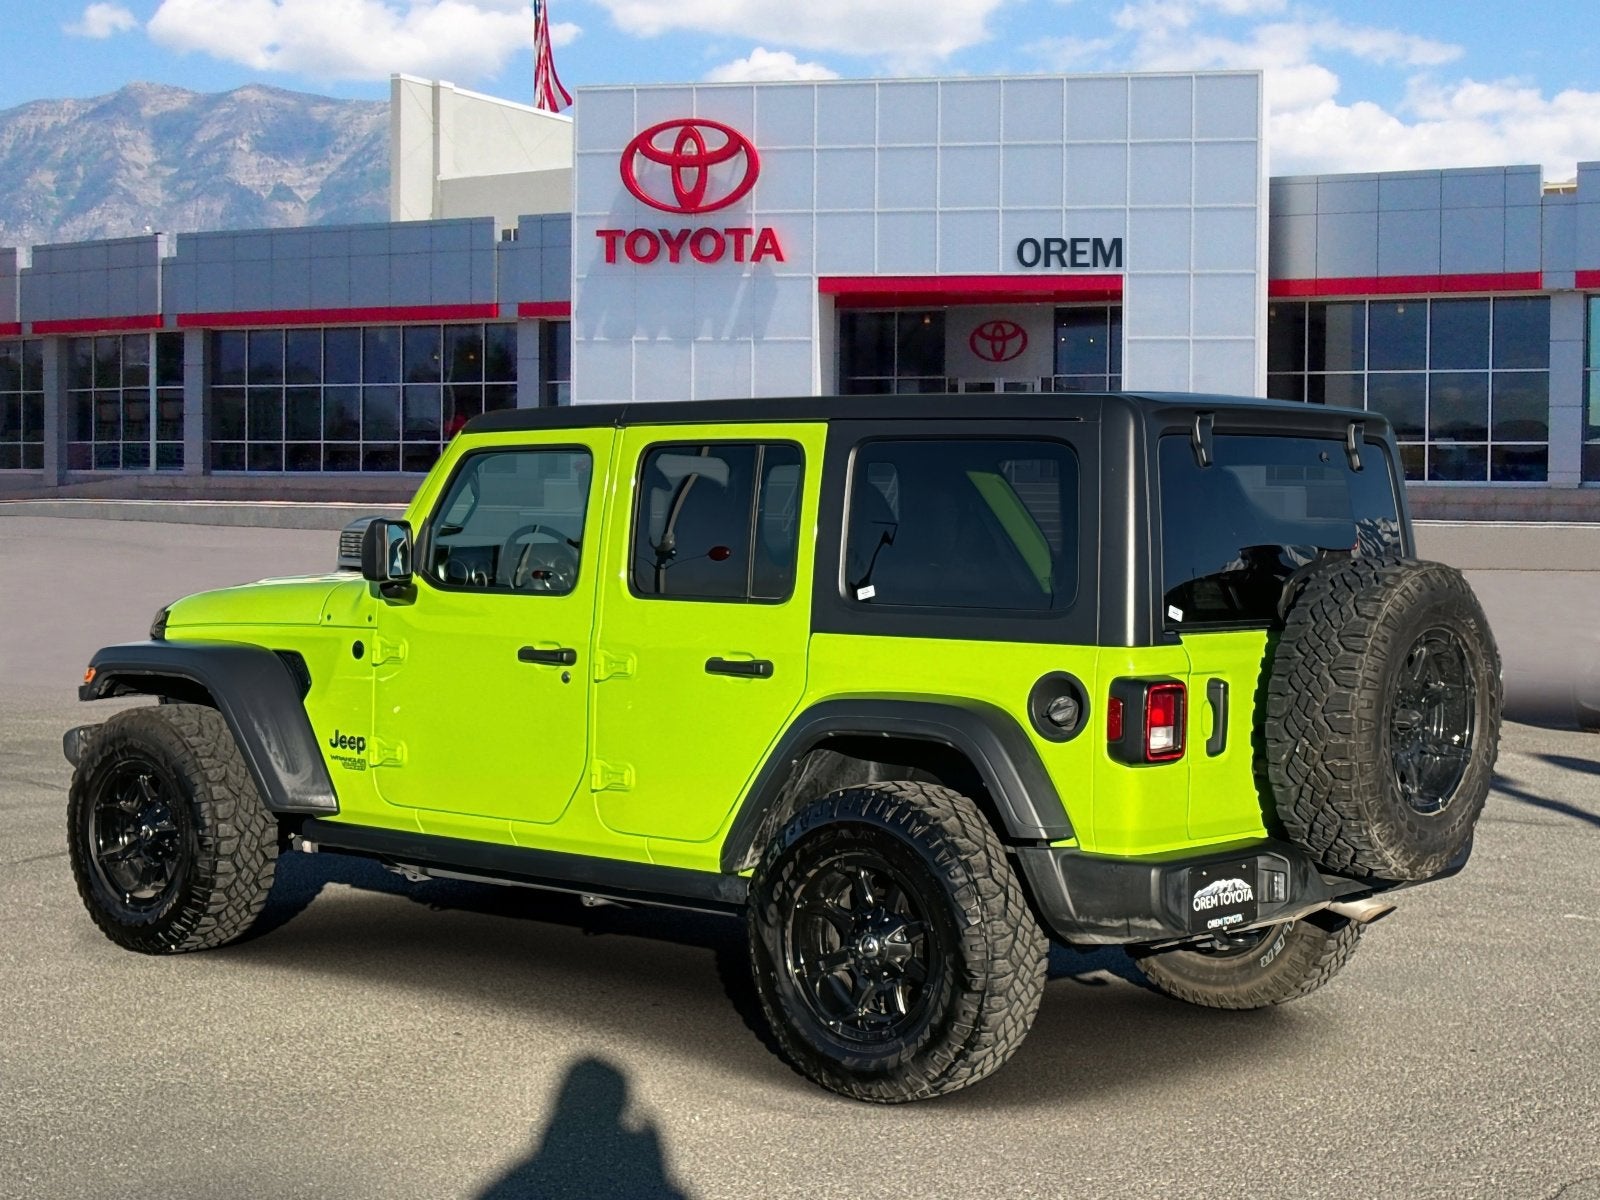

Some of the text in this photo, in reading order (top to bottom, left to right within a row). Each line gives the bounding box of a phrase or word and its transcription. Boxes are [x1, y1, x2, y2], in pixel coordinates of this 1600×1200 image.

[596, 227, 785, 264] TOYOTA
[1017, 237, 1122, 268] OREM
[329, 729, 366, 755] Jeep
[1193, 889, 1253, 911] OREM TOYOTA
